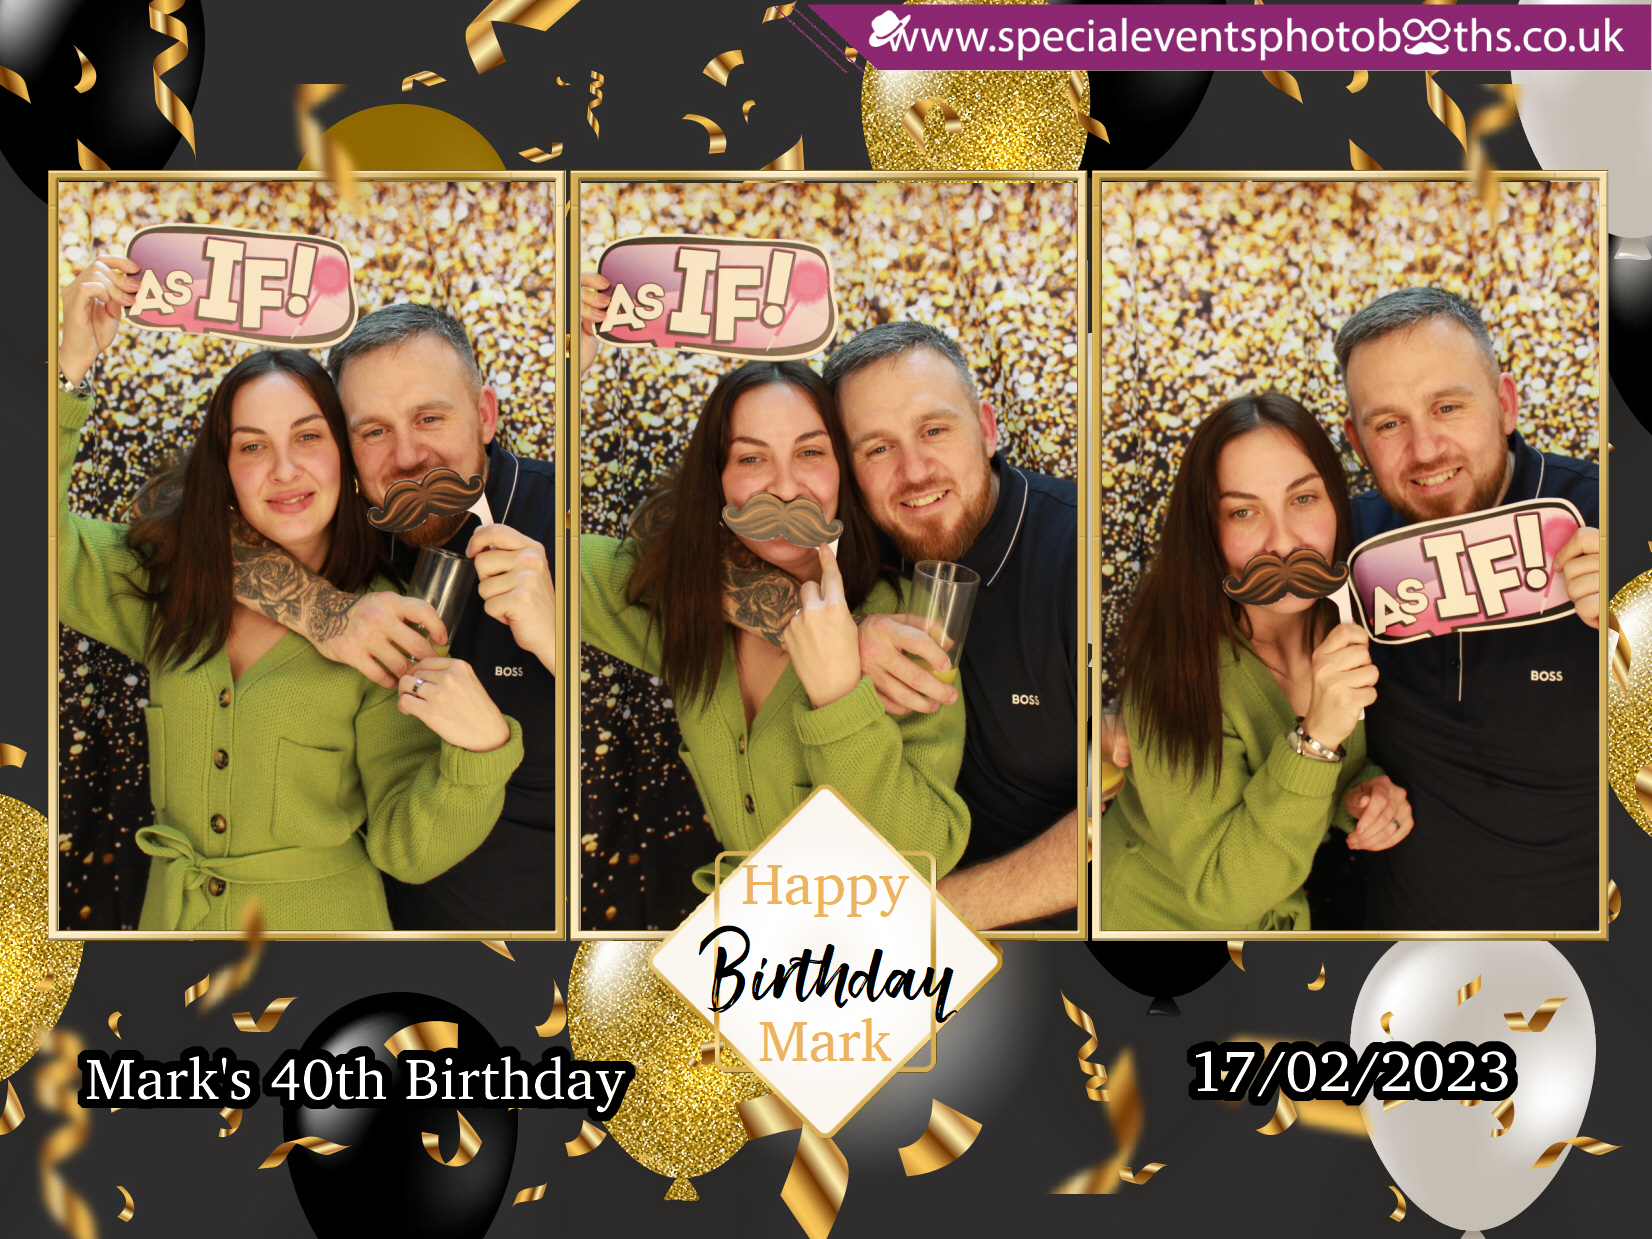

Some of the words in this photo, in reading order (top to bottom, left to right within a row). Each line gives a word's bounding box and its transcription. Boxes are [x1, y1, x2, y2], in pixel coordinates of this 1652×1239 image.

[128, 269, 193, 316] AS
[196, 236, 319, 330] IF!
[598, 282, 665, 334] AS
[668, 246, 796, 343] IF!
[1373, 578, 1429, 636] AS
[1421, 512, 1549, 619] IF!
[494, 666, 523, 677] BOSS
[1530, 669, 1564, 682] BOSS
[1011, 694, 1040, 706] BOSS
